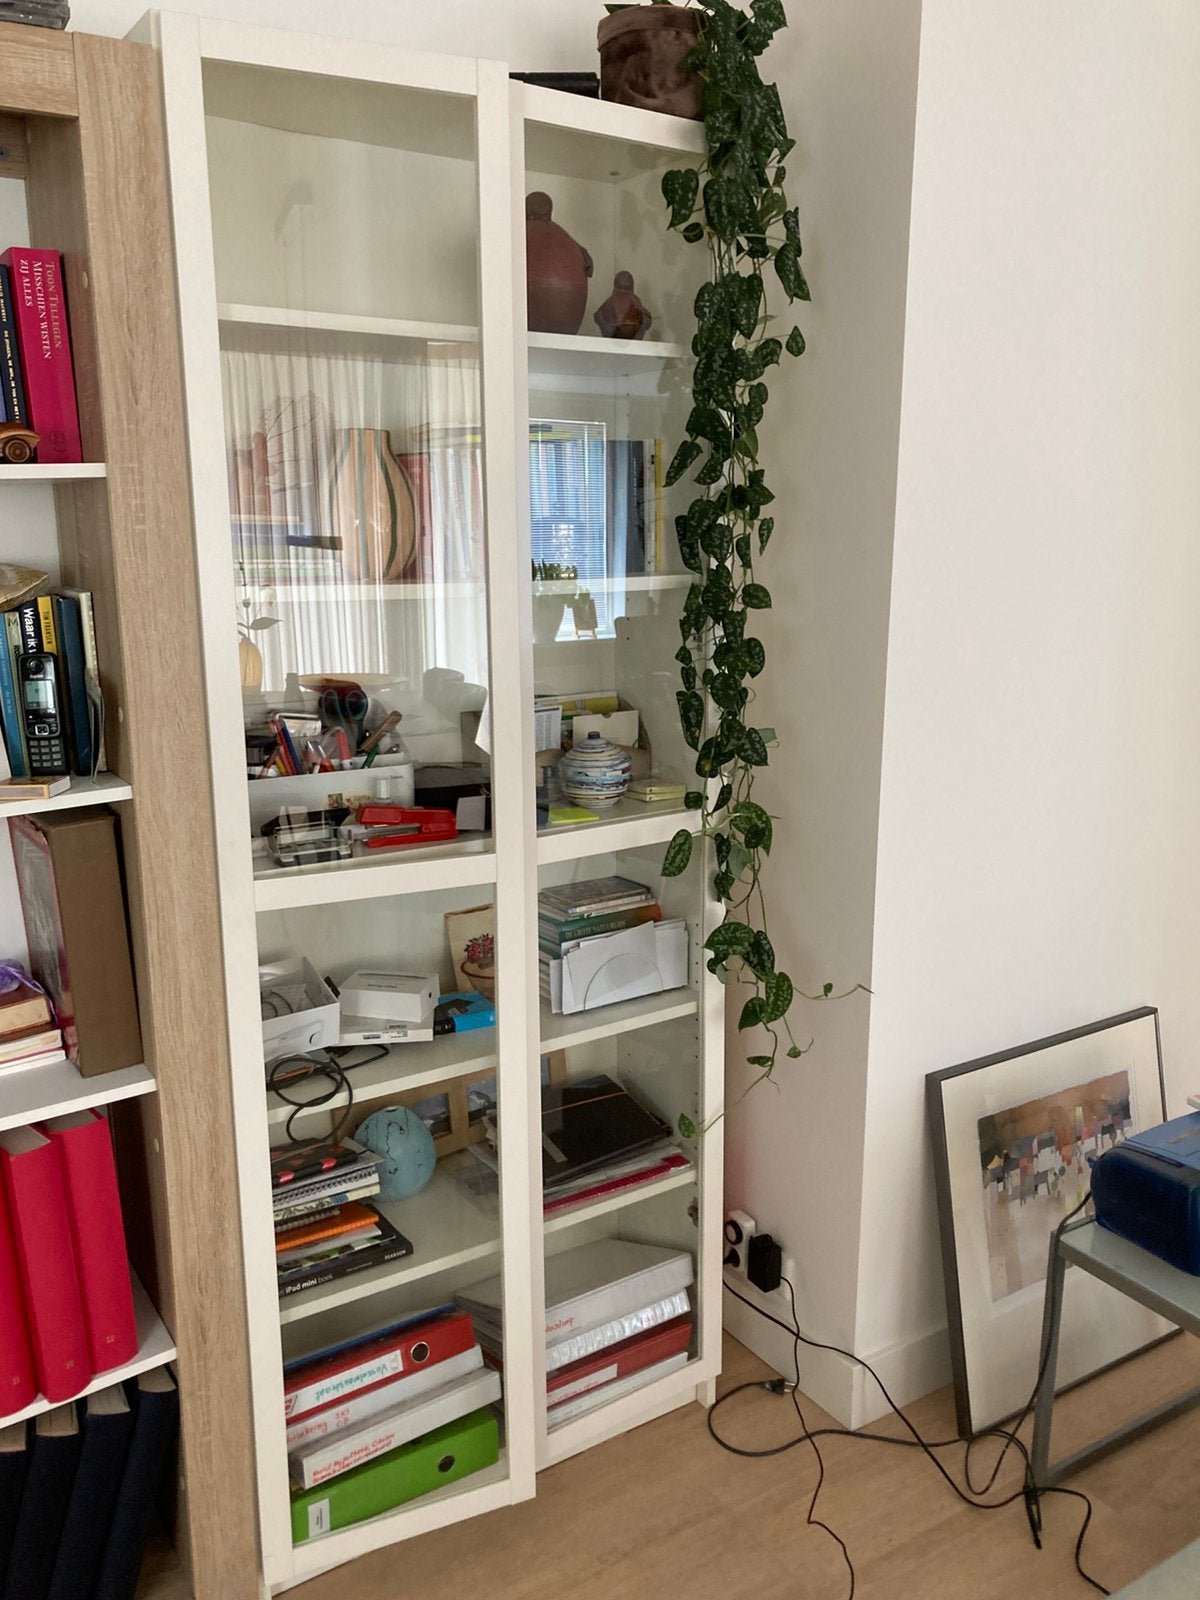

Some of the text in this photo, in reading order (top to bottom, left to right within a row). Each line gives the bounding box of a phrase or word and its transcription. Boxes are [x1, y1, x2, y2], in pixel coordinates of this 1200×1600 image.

[19, 259, 33, 307] ZIJ ALLES
[23, 607, 36, 637] Waar
[27, 638, 39, 648] ik
[384, 1249, 407, 1260] PEARSON
[285, 1281, 301, 1294] iPad
[302, 1278, 318, 1290] mini
